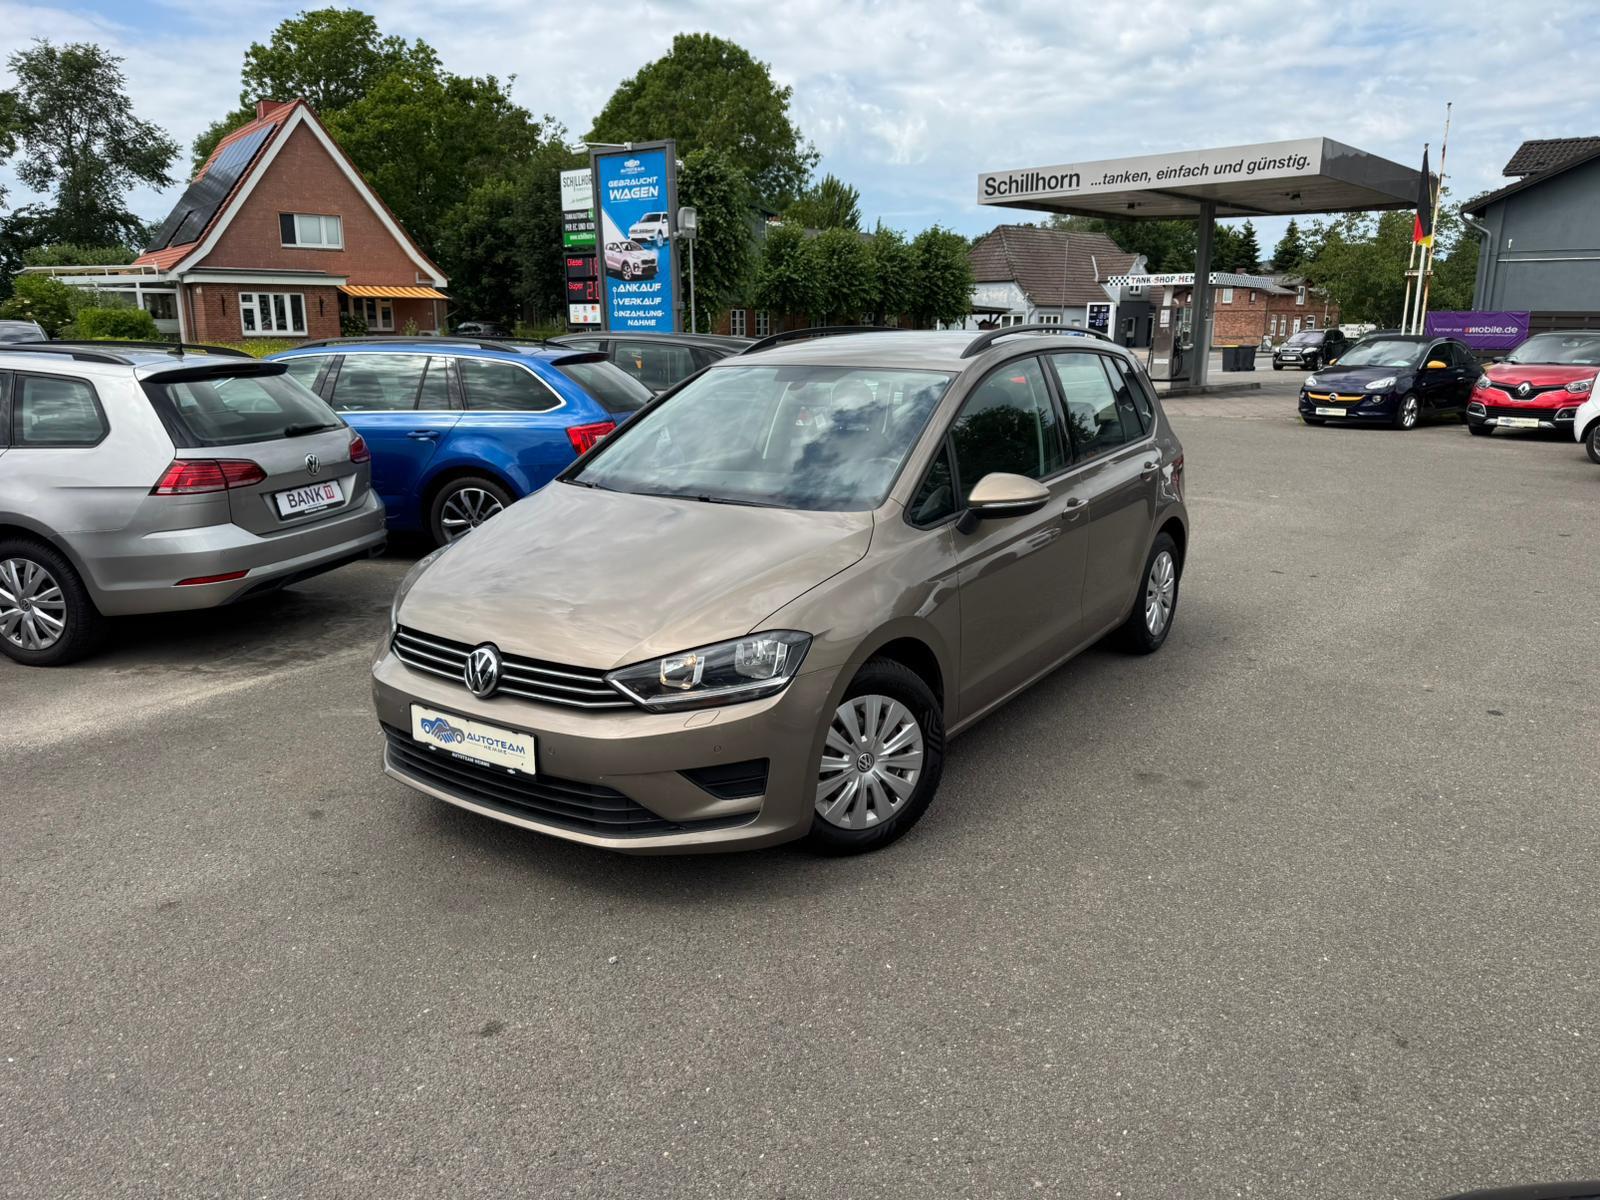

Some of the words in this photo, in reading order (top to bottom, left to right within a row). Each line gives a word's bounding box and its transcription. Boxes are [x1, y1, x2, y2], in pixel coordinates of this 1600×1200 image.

[984, 172, 1081, 196] Schillhorn
[1090, 170, 1152, 186] ...tanken,
[1156, 163, 1210, 180] einfach
[1213, 159, 1244, 175] und
[1246, 153, 1311, 175] günstig.
[608, 176, 658, 188] GEBRAUCHT
[609, 185, 659, 200] WAGEN
[1154, 276, 1176, 284] SHOP
[617, 283, 662, 293] ANKAUF
[617, 297, 662, 305] VERKAUF
[1464, 325, 1518, 334] mobile.de
[286, 486, 325, 508] BANK
[466, 731, 526, 755] AUTOTEAM
